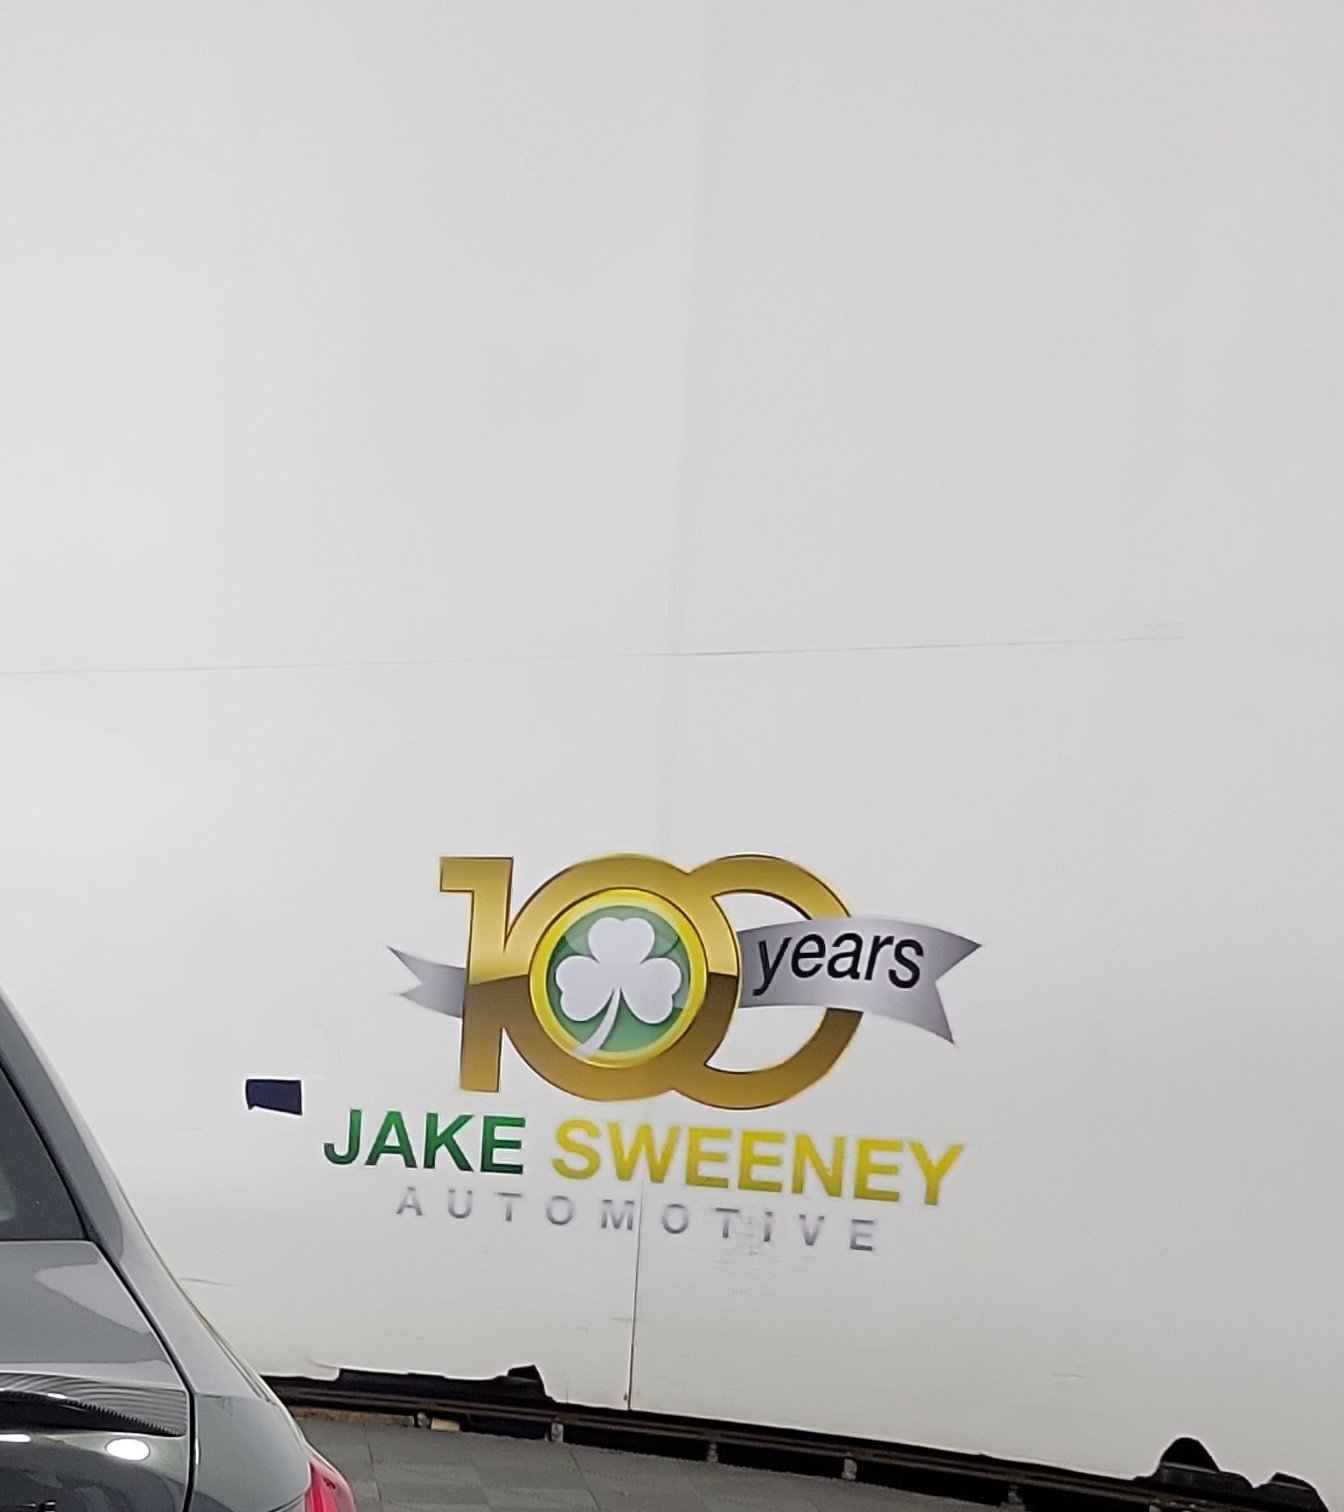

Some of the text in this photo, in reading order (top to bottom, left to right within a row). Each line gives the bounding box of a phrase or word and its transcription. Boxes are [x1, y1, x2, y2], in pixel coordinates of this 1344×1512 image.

[439, 854, 863, 1109] 100
[753, 932, 925, 996] years
[324, 1109, 964, 1206] JAKE SWEENEY
[396, 1187, 876, 1251] AUTOMOTIVE
